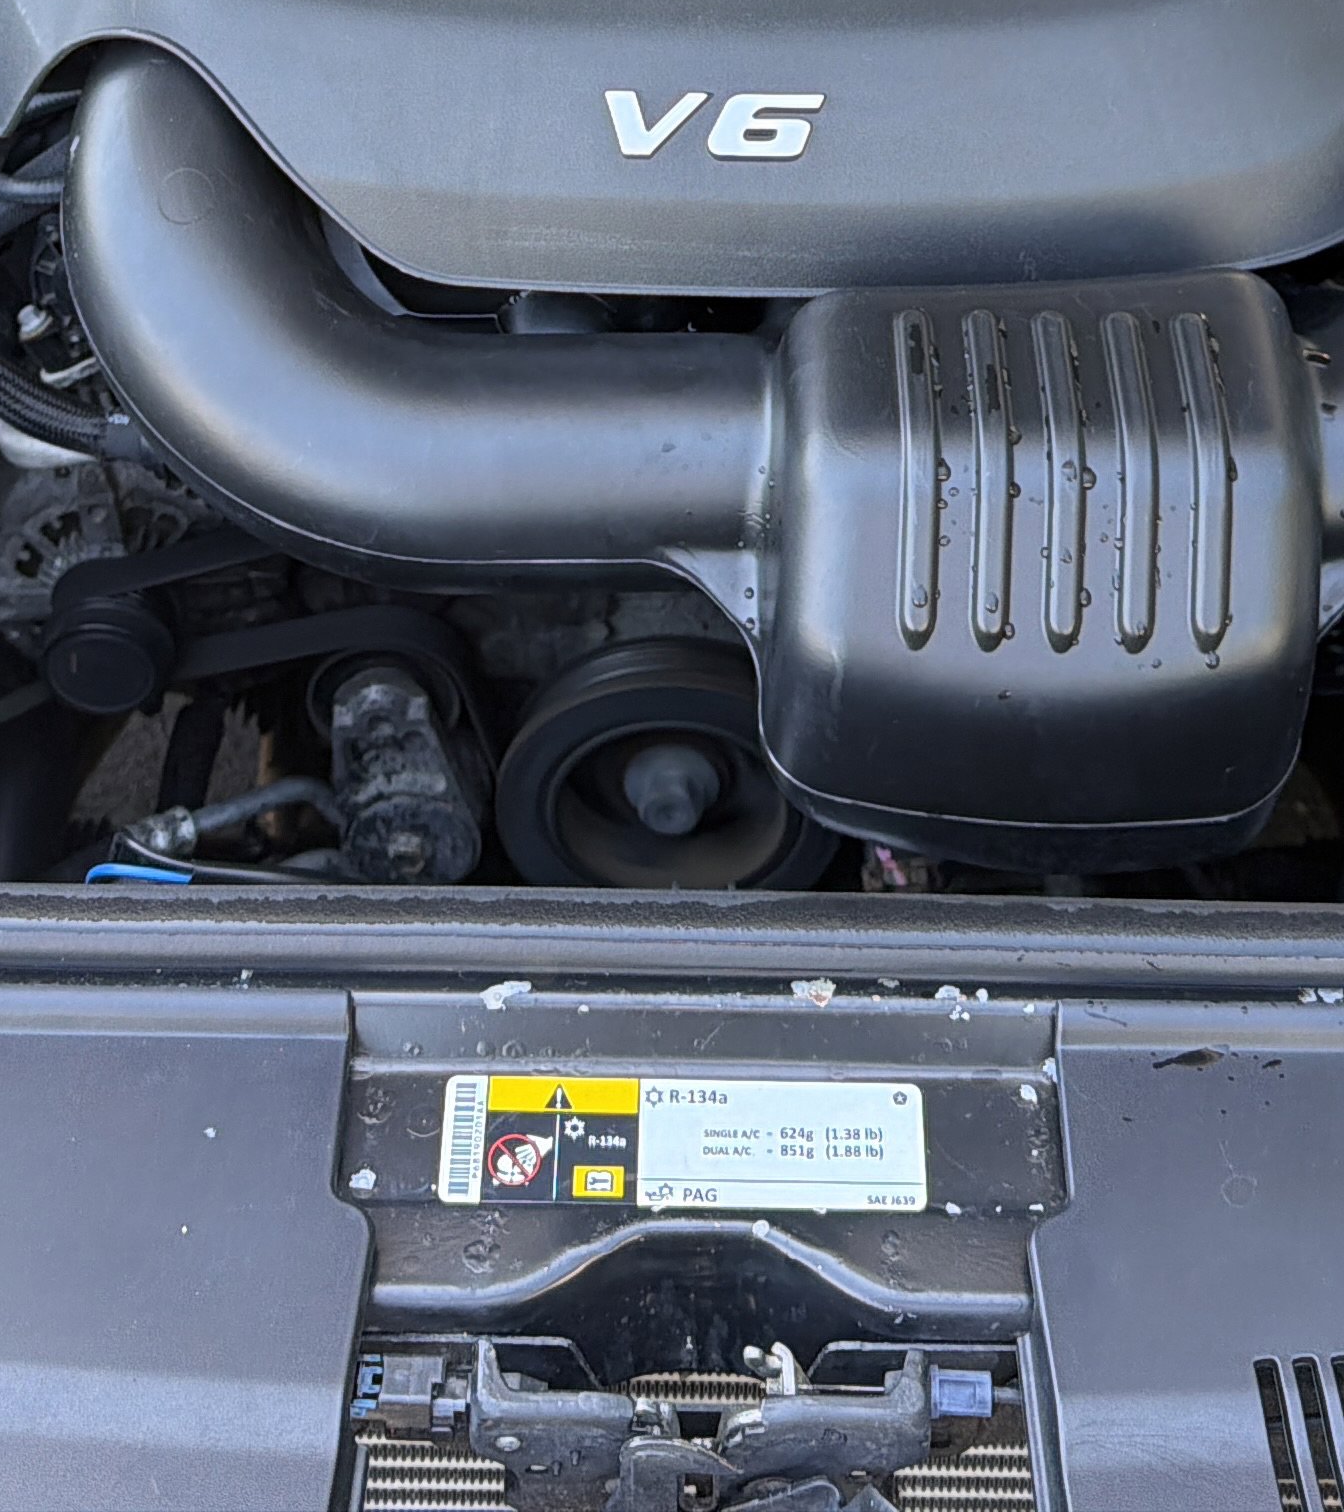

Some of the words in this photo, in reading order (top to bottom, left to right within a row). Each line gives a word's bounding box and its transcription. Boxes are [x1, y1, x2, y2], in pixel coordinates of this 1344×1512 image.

[604, 90, 828, 160] V6
[669, 1089, 729, 1105] R-134a
[588, 1135, 627, 1149] R-134a
[703, 1129, 739, 1140] SINGLE
[740, 1129, 761, 1140] A/C
[779, 1127, 815, 1142] 624g
[824, 1128, 862, 1142] (1.38
[864, 1127, 884, 1142] lb)
[702, 1146, 730, 1157] DUAL
[779, 1145, 815, 1159] 851g
[825, 1145, 863, 1160] (1.88
[864, 1145, 885, 1161] lb)
[682, 1187, 718, 1203] PAG
[867, 1194, 888, 1206] SAE
[891, 1195, 916, 1206] J639
